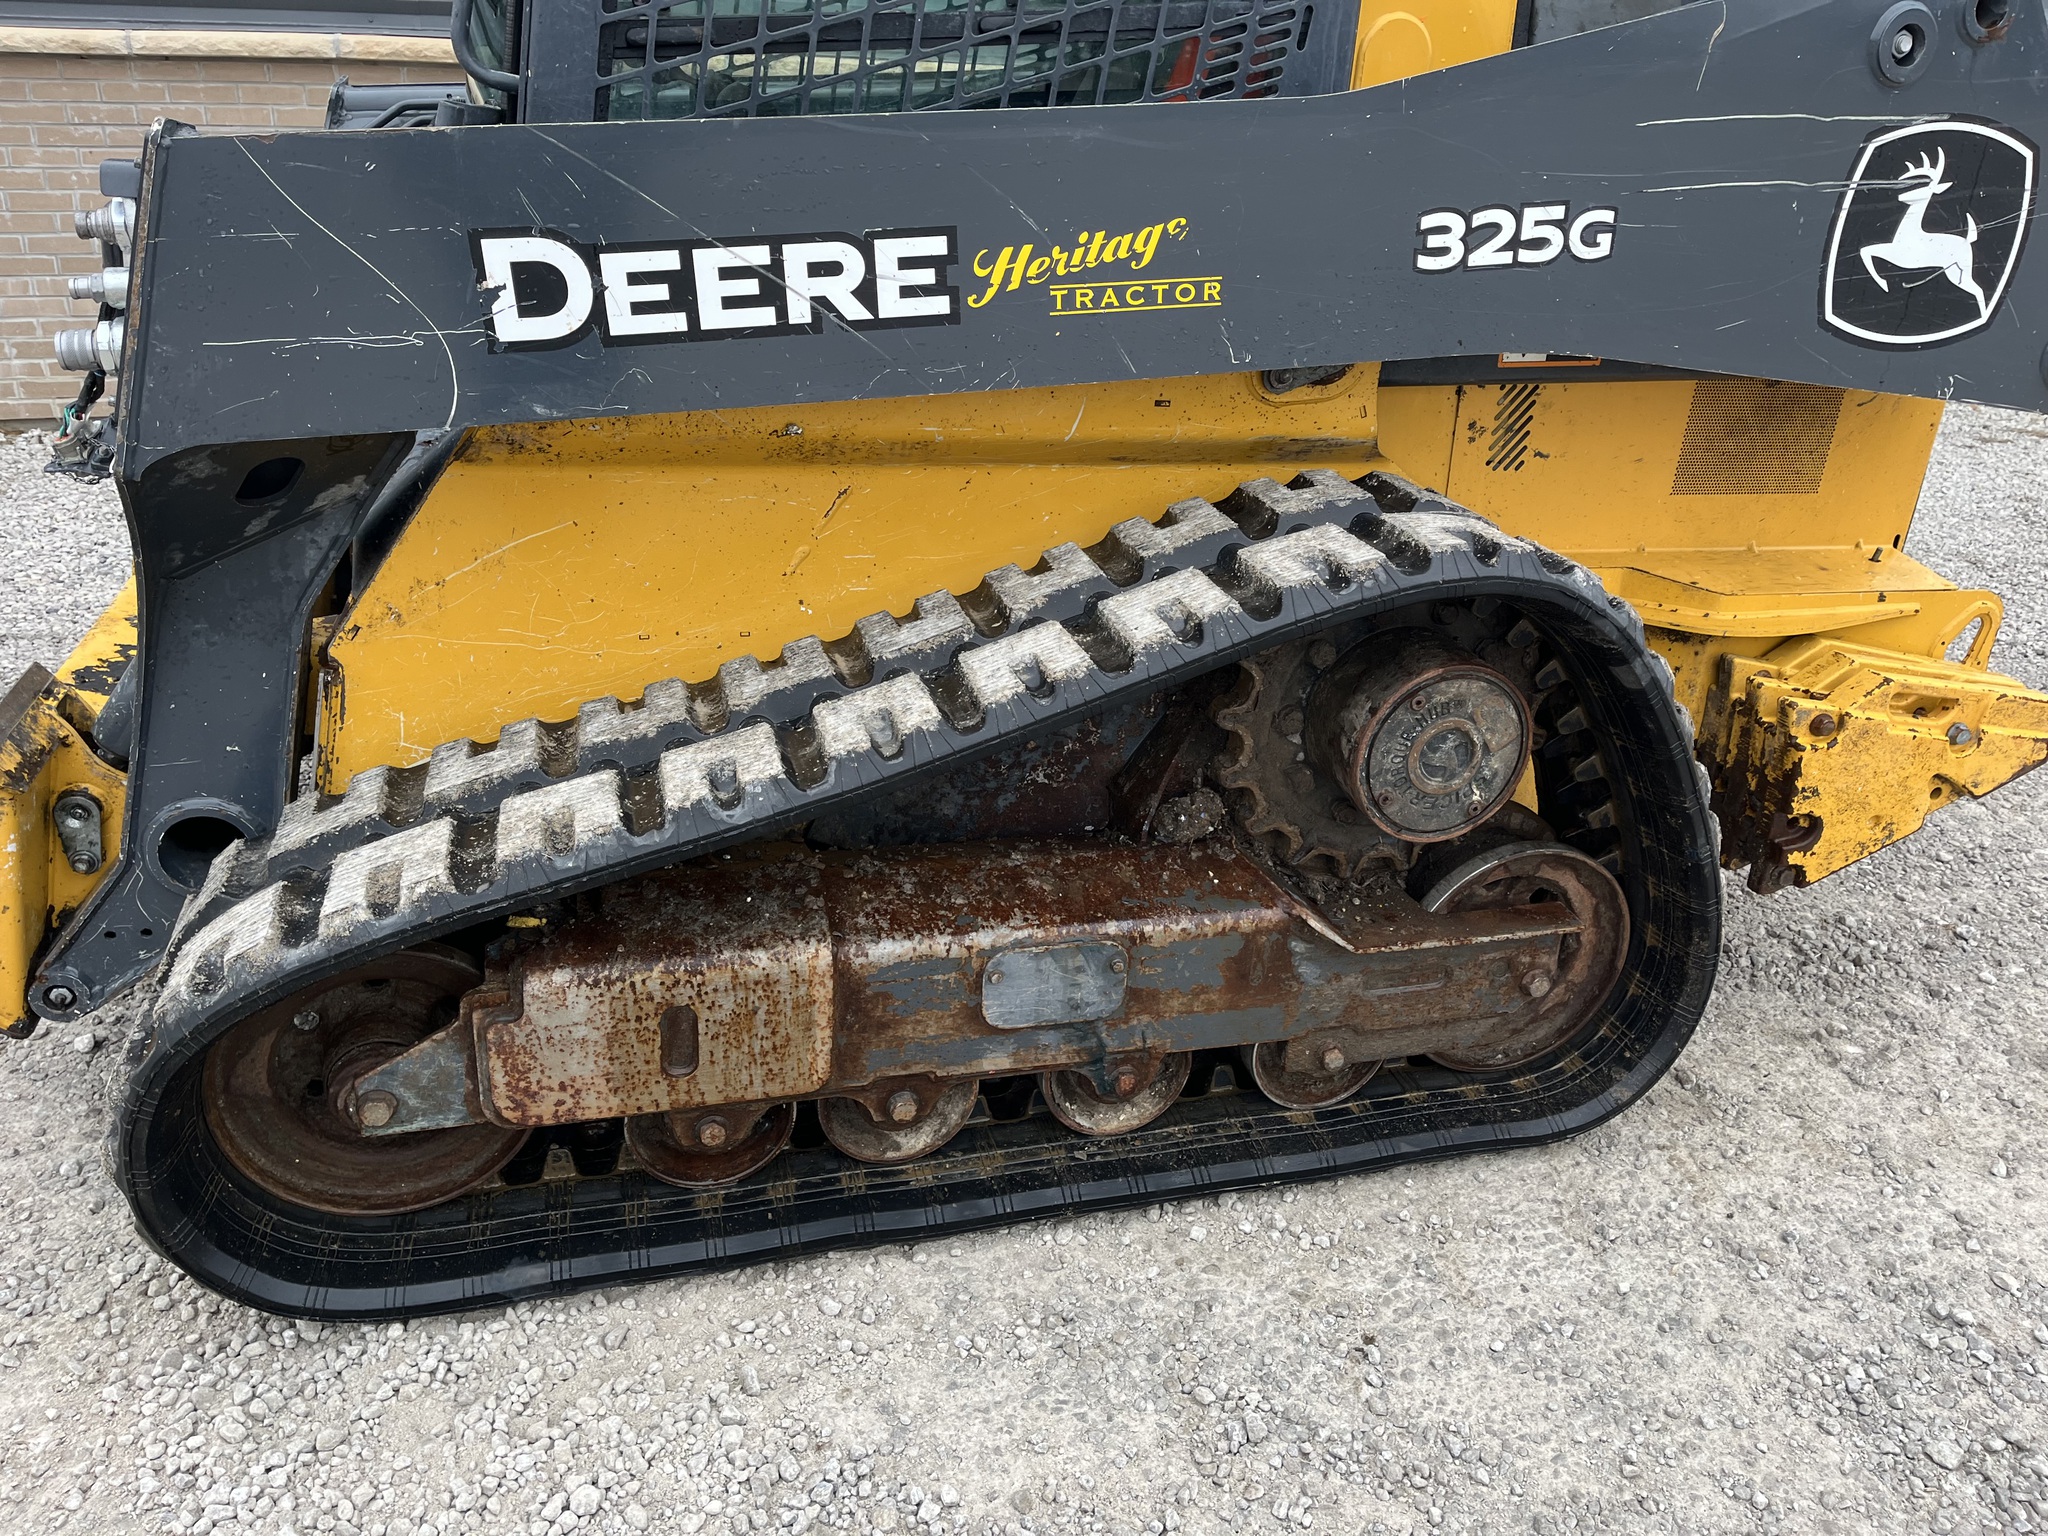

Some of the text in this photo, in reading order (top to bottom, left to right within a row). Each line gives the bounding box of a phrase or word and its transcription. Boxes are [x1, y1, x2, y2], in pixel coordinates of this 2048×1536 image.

[967, 217, 1190, 309] Heritage
[1416, 205, 1616, 270] 325G
[481, 236, 951, 342] DEERE
[1050, 282, 1221, 310] TRACTOR
